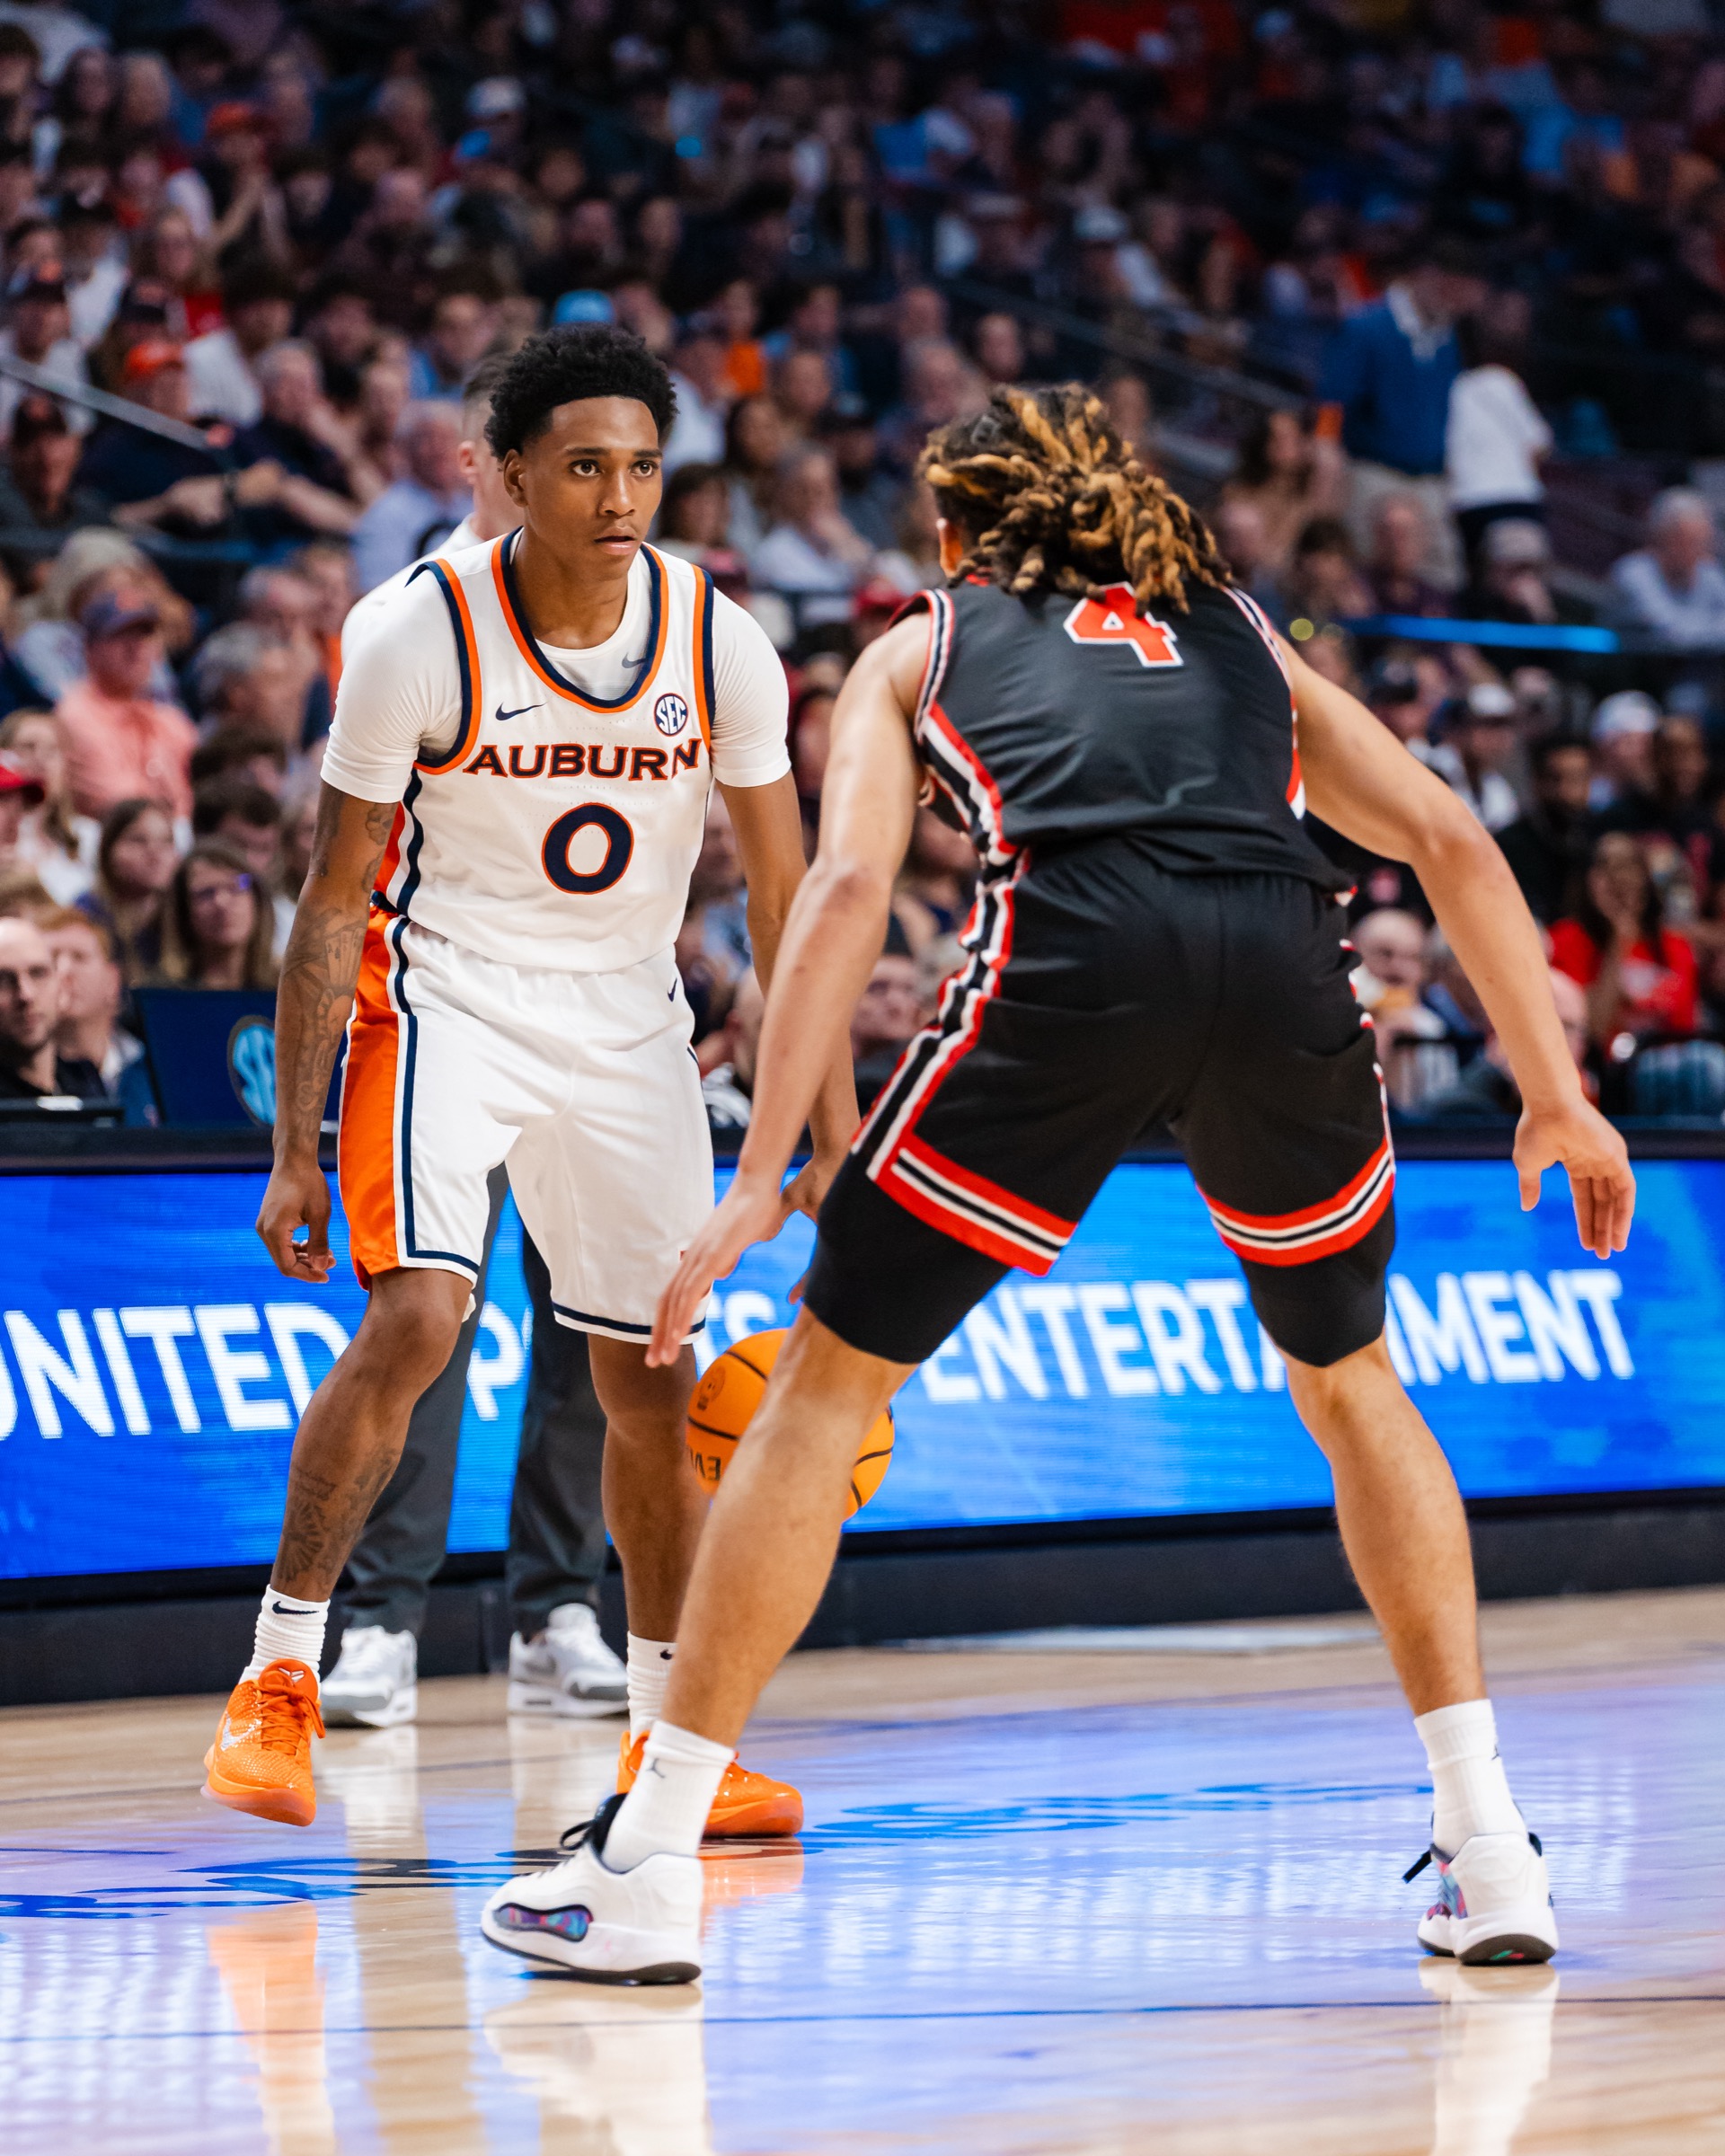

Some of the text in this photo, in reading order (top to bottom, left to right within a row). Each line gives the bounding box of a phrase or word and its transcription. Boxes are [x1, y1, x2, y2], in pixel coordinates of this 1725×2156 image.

[1063, 581, 1184, 667] 4
[655, 694, 687, 736] SEC
[463, 738, 703, 781] AUBURN
[541, 802, 634, 895] 0
[0, 1303, 349, 1440] NITED
[920, 1268, 1634, 1404] ENTERTMENT
